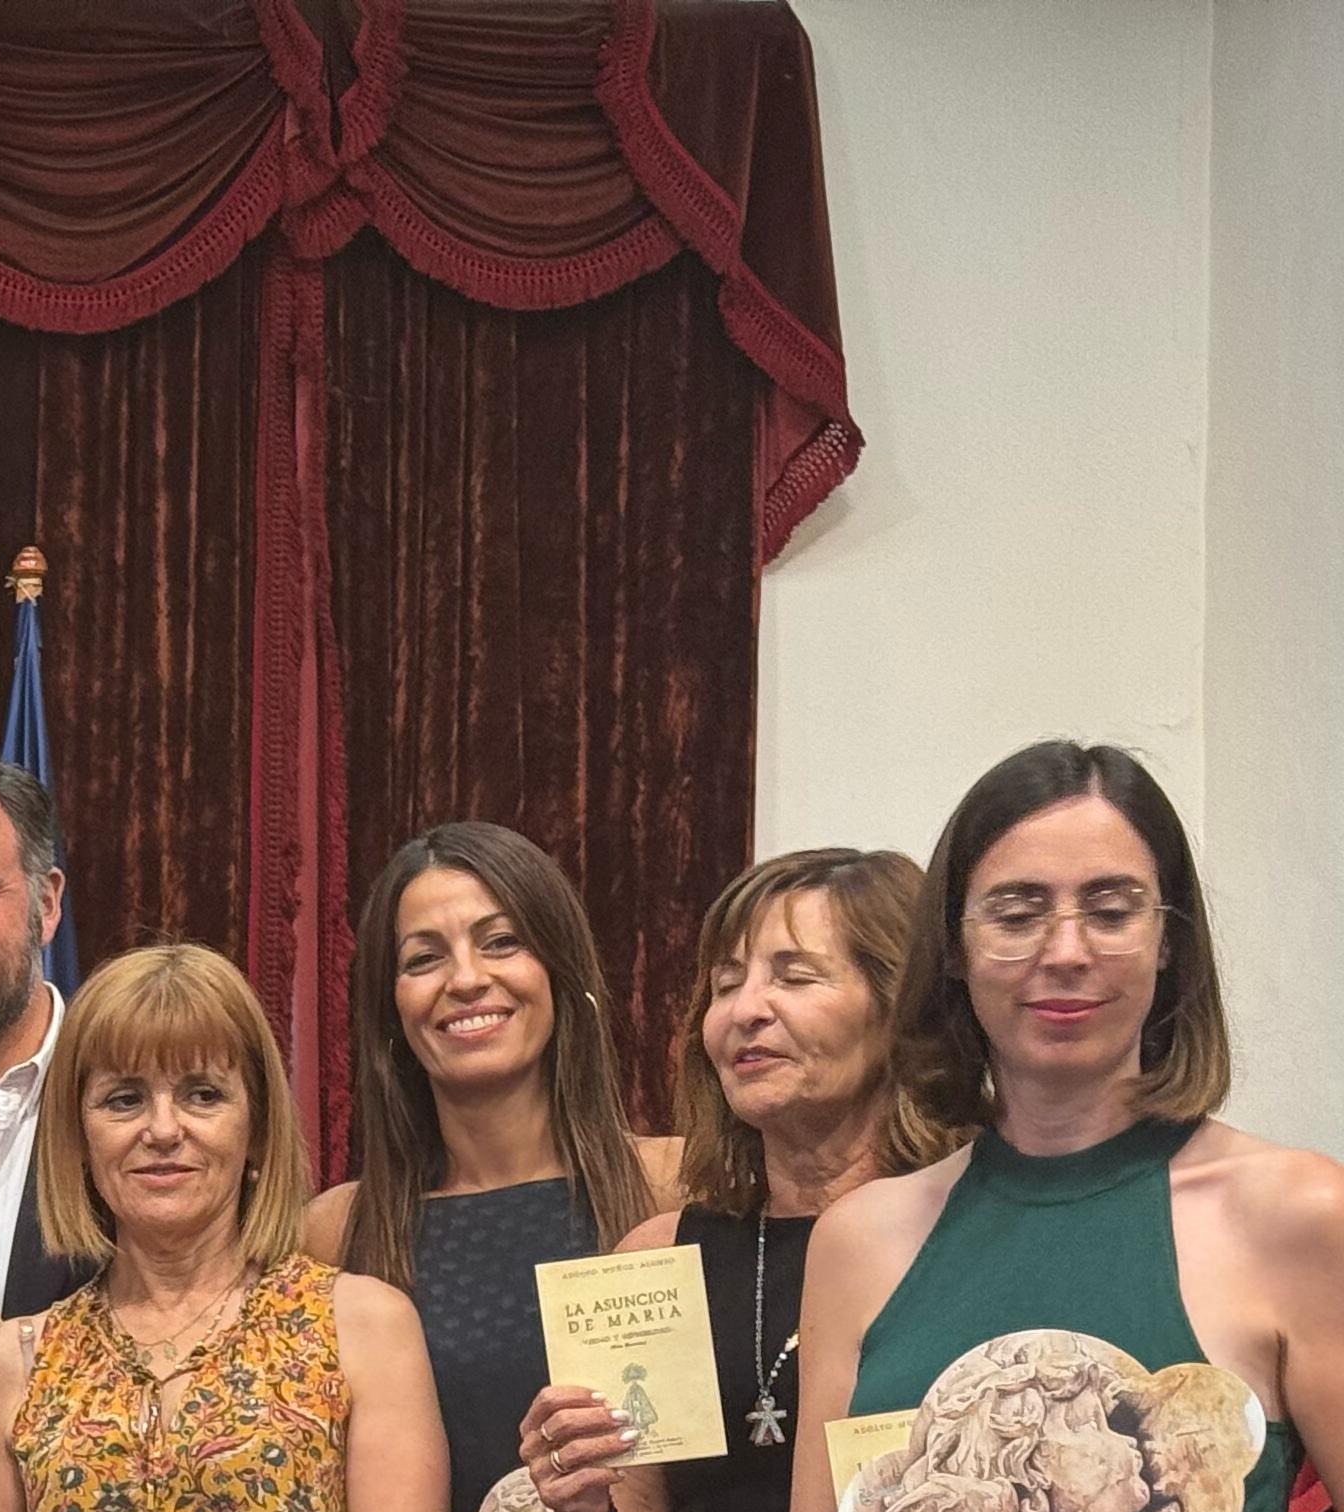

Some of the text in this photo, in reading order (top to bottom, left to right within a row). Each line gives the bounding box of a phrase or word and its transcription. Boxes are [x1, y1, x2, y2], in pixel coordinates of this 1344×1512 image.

[565, 1287, 679, 1318] LA ASUNCION
[568, 1305, 682, 1334] DE MARIA
